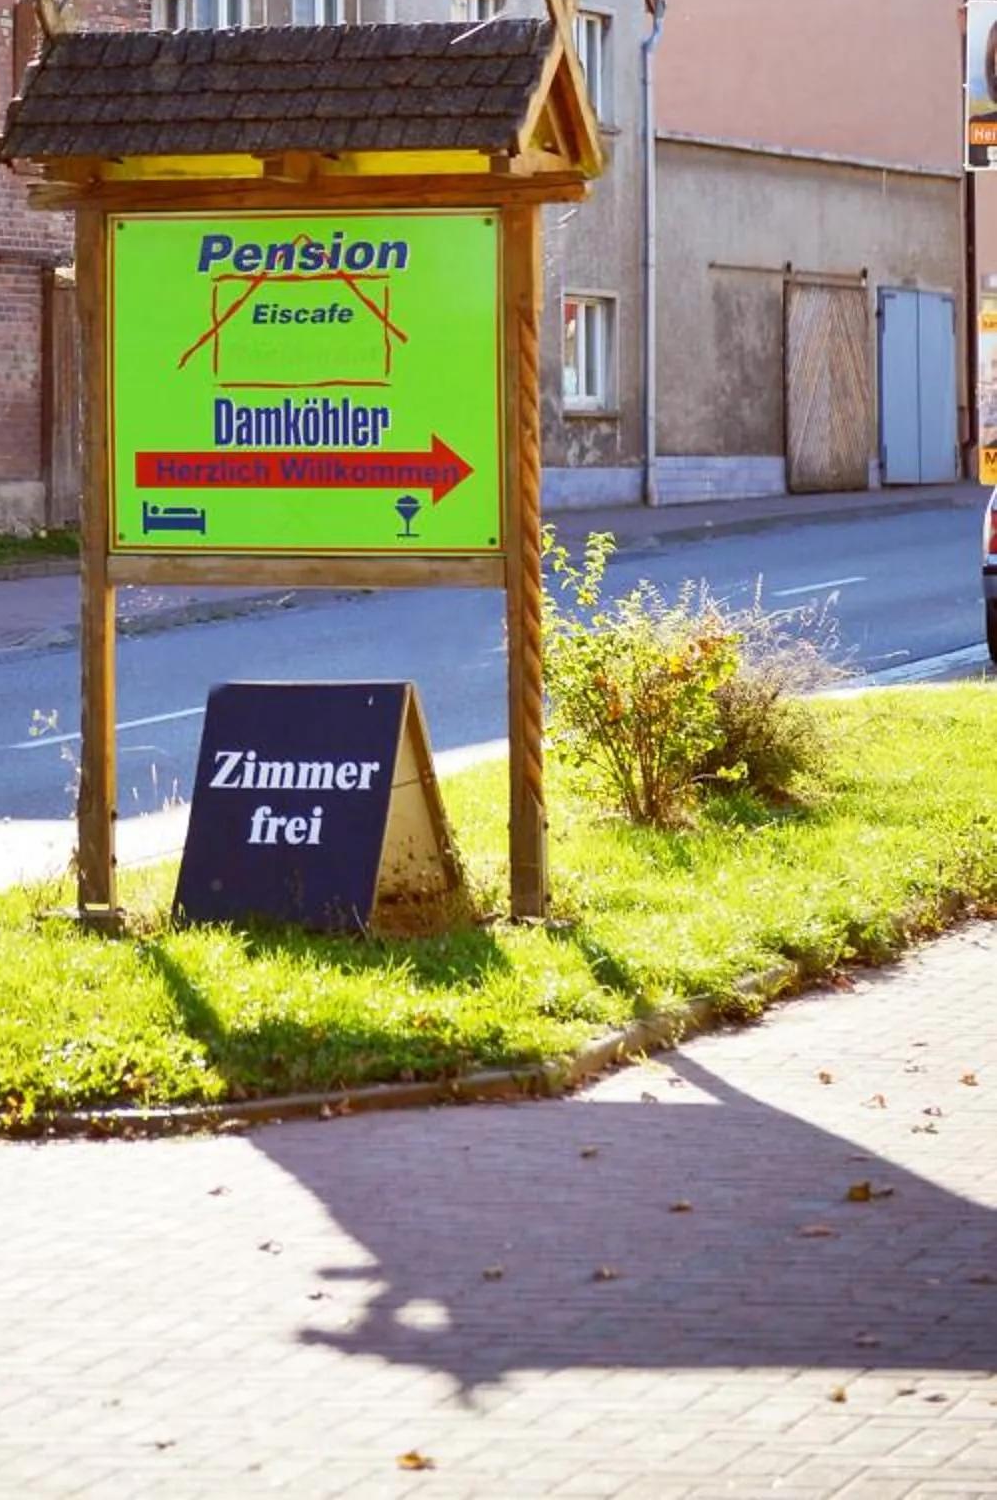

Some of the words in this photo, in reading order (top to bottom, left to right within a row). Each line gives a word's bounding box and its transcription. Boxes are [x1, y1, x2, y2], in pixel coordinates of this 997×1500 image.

[197, 231, 408, 273] Pension
[252, 303, 354, 325] Eiscafe
[214, 398, 390, 448] Damköhler
[156, 457, 269, 482] Herzlich
[280, 457, 461, 483] Willkommen
[209, 750, 380, 790] Zimmer
[247, 805, 324, 845] frei
